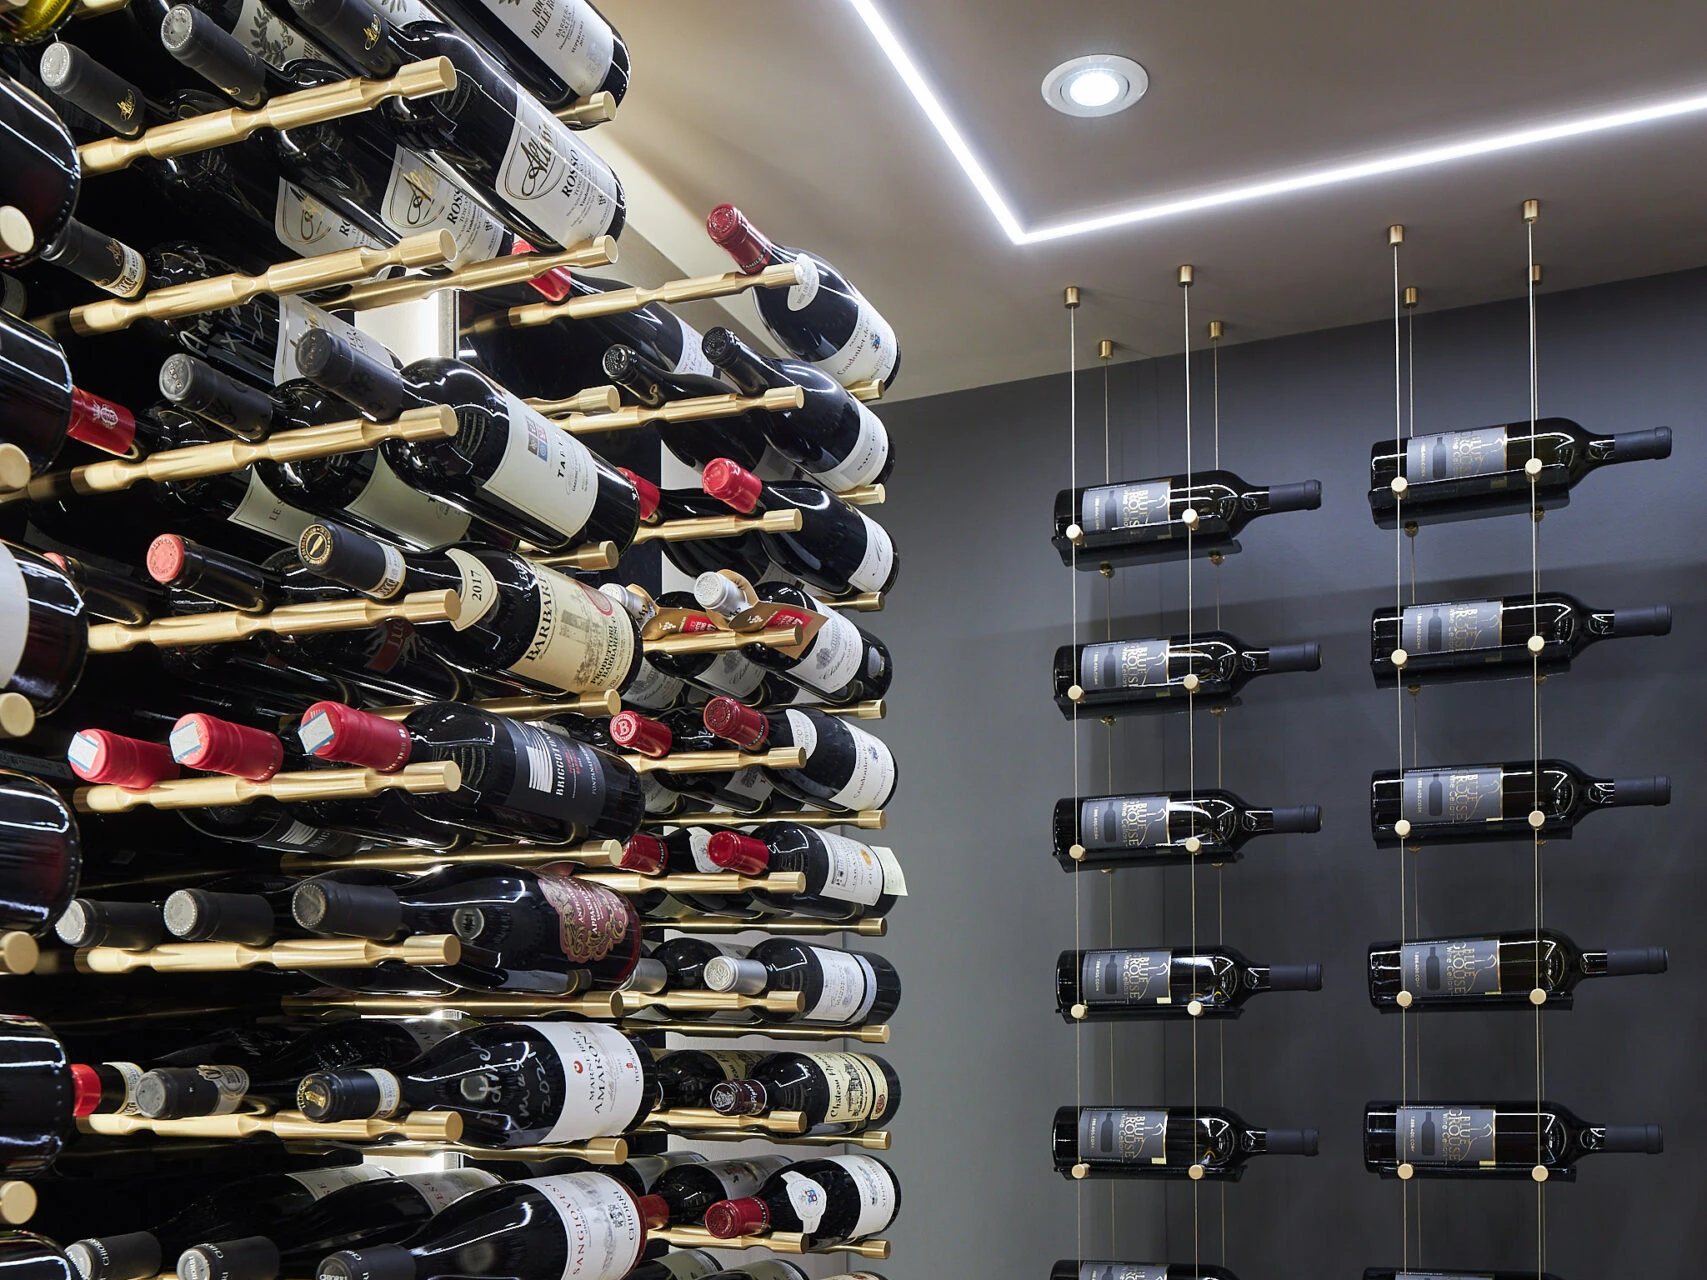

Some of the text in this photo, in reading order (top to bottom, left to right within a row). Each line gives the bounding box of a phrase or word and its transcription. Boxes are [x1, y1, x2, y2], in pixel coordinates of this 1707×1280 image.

[531, 7, 552, 38] DELLE
[561, 149, 579, 198] ROSSO
[446, 187, 465, 225] ROSS
[471, 569, 482, 601] 2017
[1467, 608, 1478, 637] BLUE
[590, 626, 617, 684] PRODUTTORI
[1139, 647, 1148, 673] BLUE
[1456, 774, 1468, 821] ROUSE
[1468, 774, 1478, 801] BLUE
[1129, 801, 1140, 846] ROUSE
[1139, 803, 1147, 829] BLUE
[1129, 956, 1140, 998] ROUSE
[1139, 957, 1149, 982] BLUE
[1452, 942, 1466, 994] GROUSE
[1464, 948, 1475, 977] BLUE
[575, 1028, 606, 1115] AMARONE
[585, 1058, 597, 1101] MARNE
[1125, 1115, 1135, 1157] ROUSE
[1135, 1116, 1145, 1142] BLUE
[1447, 1109, 1461, 1160] GROUSE
[1459, 1116, 1470, 1145] BLUE
[543, 1181, 587, 1276] SANGIOVESE
[613, 1190, 635, 1241] CHIORRI
